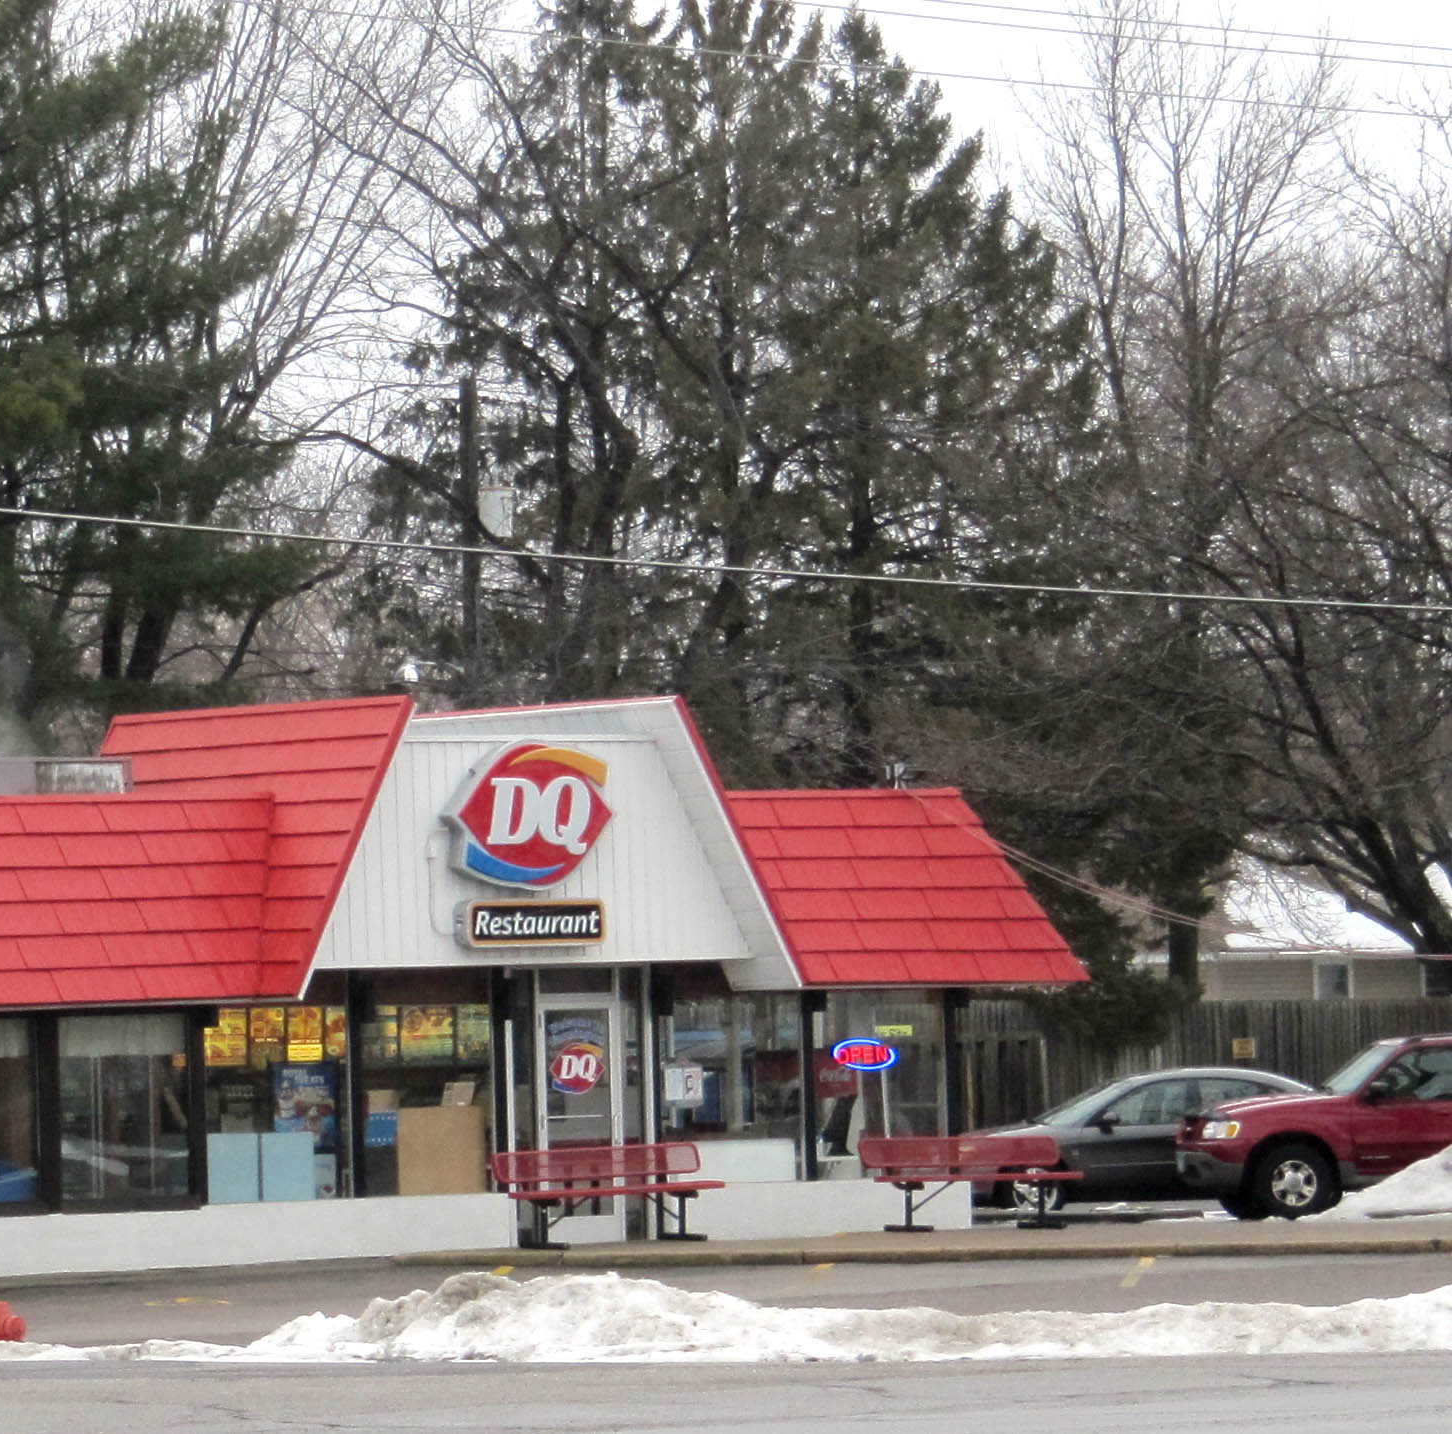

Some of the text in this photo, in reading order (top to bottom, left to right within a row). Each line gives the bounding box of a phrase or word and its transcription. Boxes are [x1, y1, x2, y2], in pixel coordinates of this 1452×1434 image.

[486, 775, 591, 855] DQ
[474, 910, 600, 936] Restaurant
[559, 1053, 597, 1082] DQ
[835, 1045, 889, 1065] OPEN
